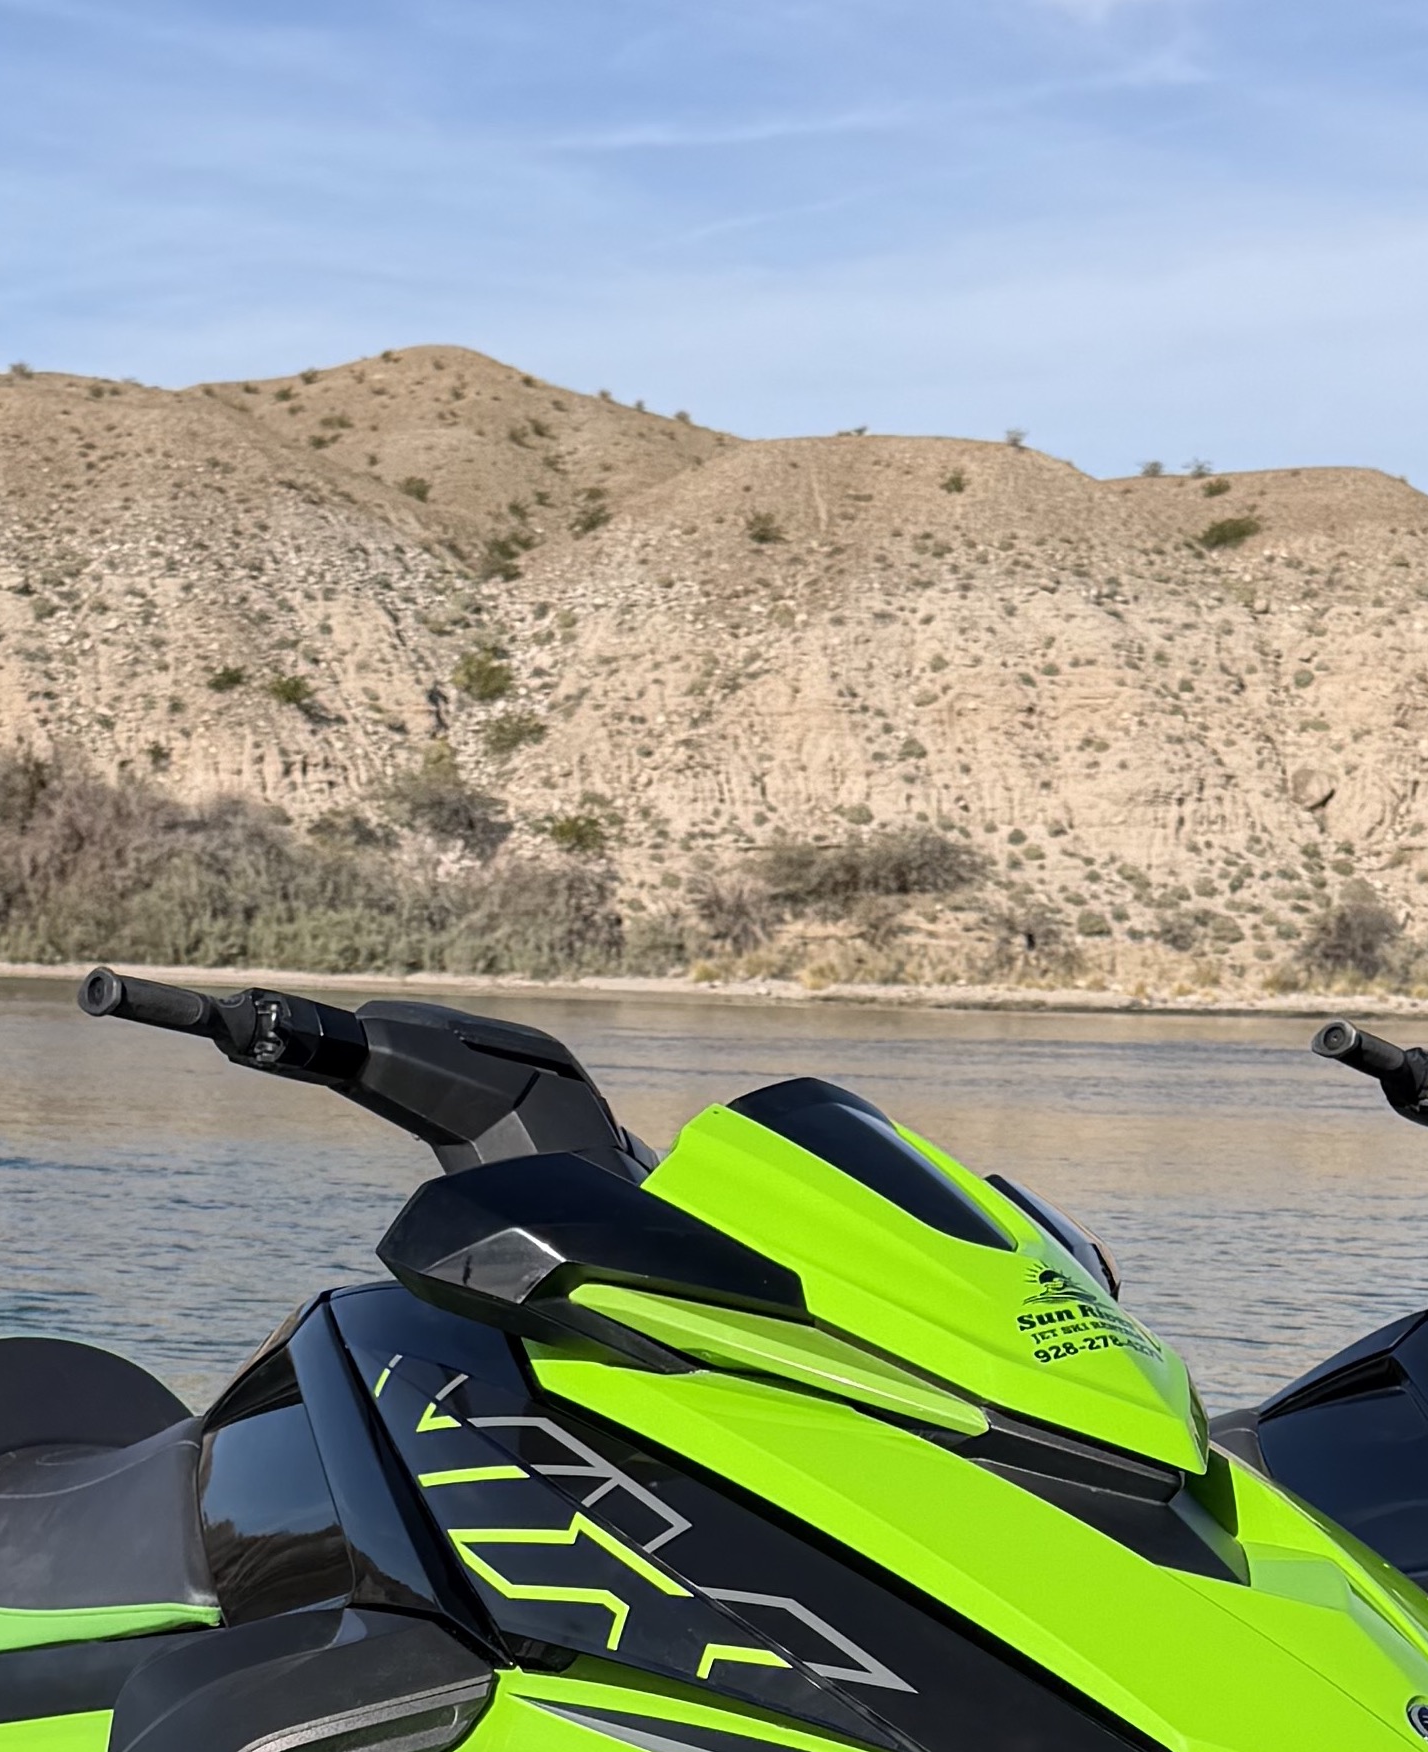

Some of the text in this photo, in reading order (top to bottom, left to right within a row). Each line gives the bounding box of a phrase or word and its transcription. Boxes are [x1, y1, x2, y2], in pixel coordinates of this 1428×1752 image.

[1017, 1309, 1075, 1331] Sun
[1031, 1329, 1059, 1345] JET
[1061, 1322, 1090, 1334] SKI
